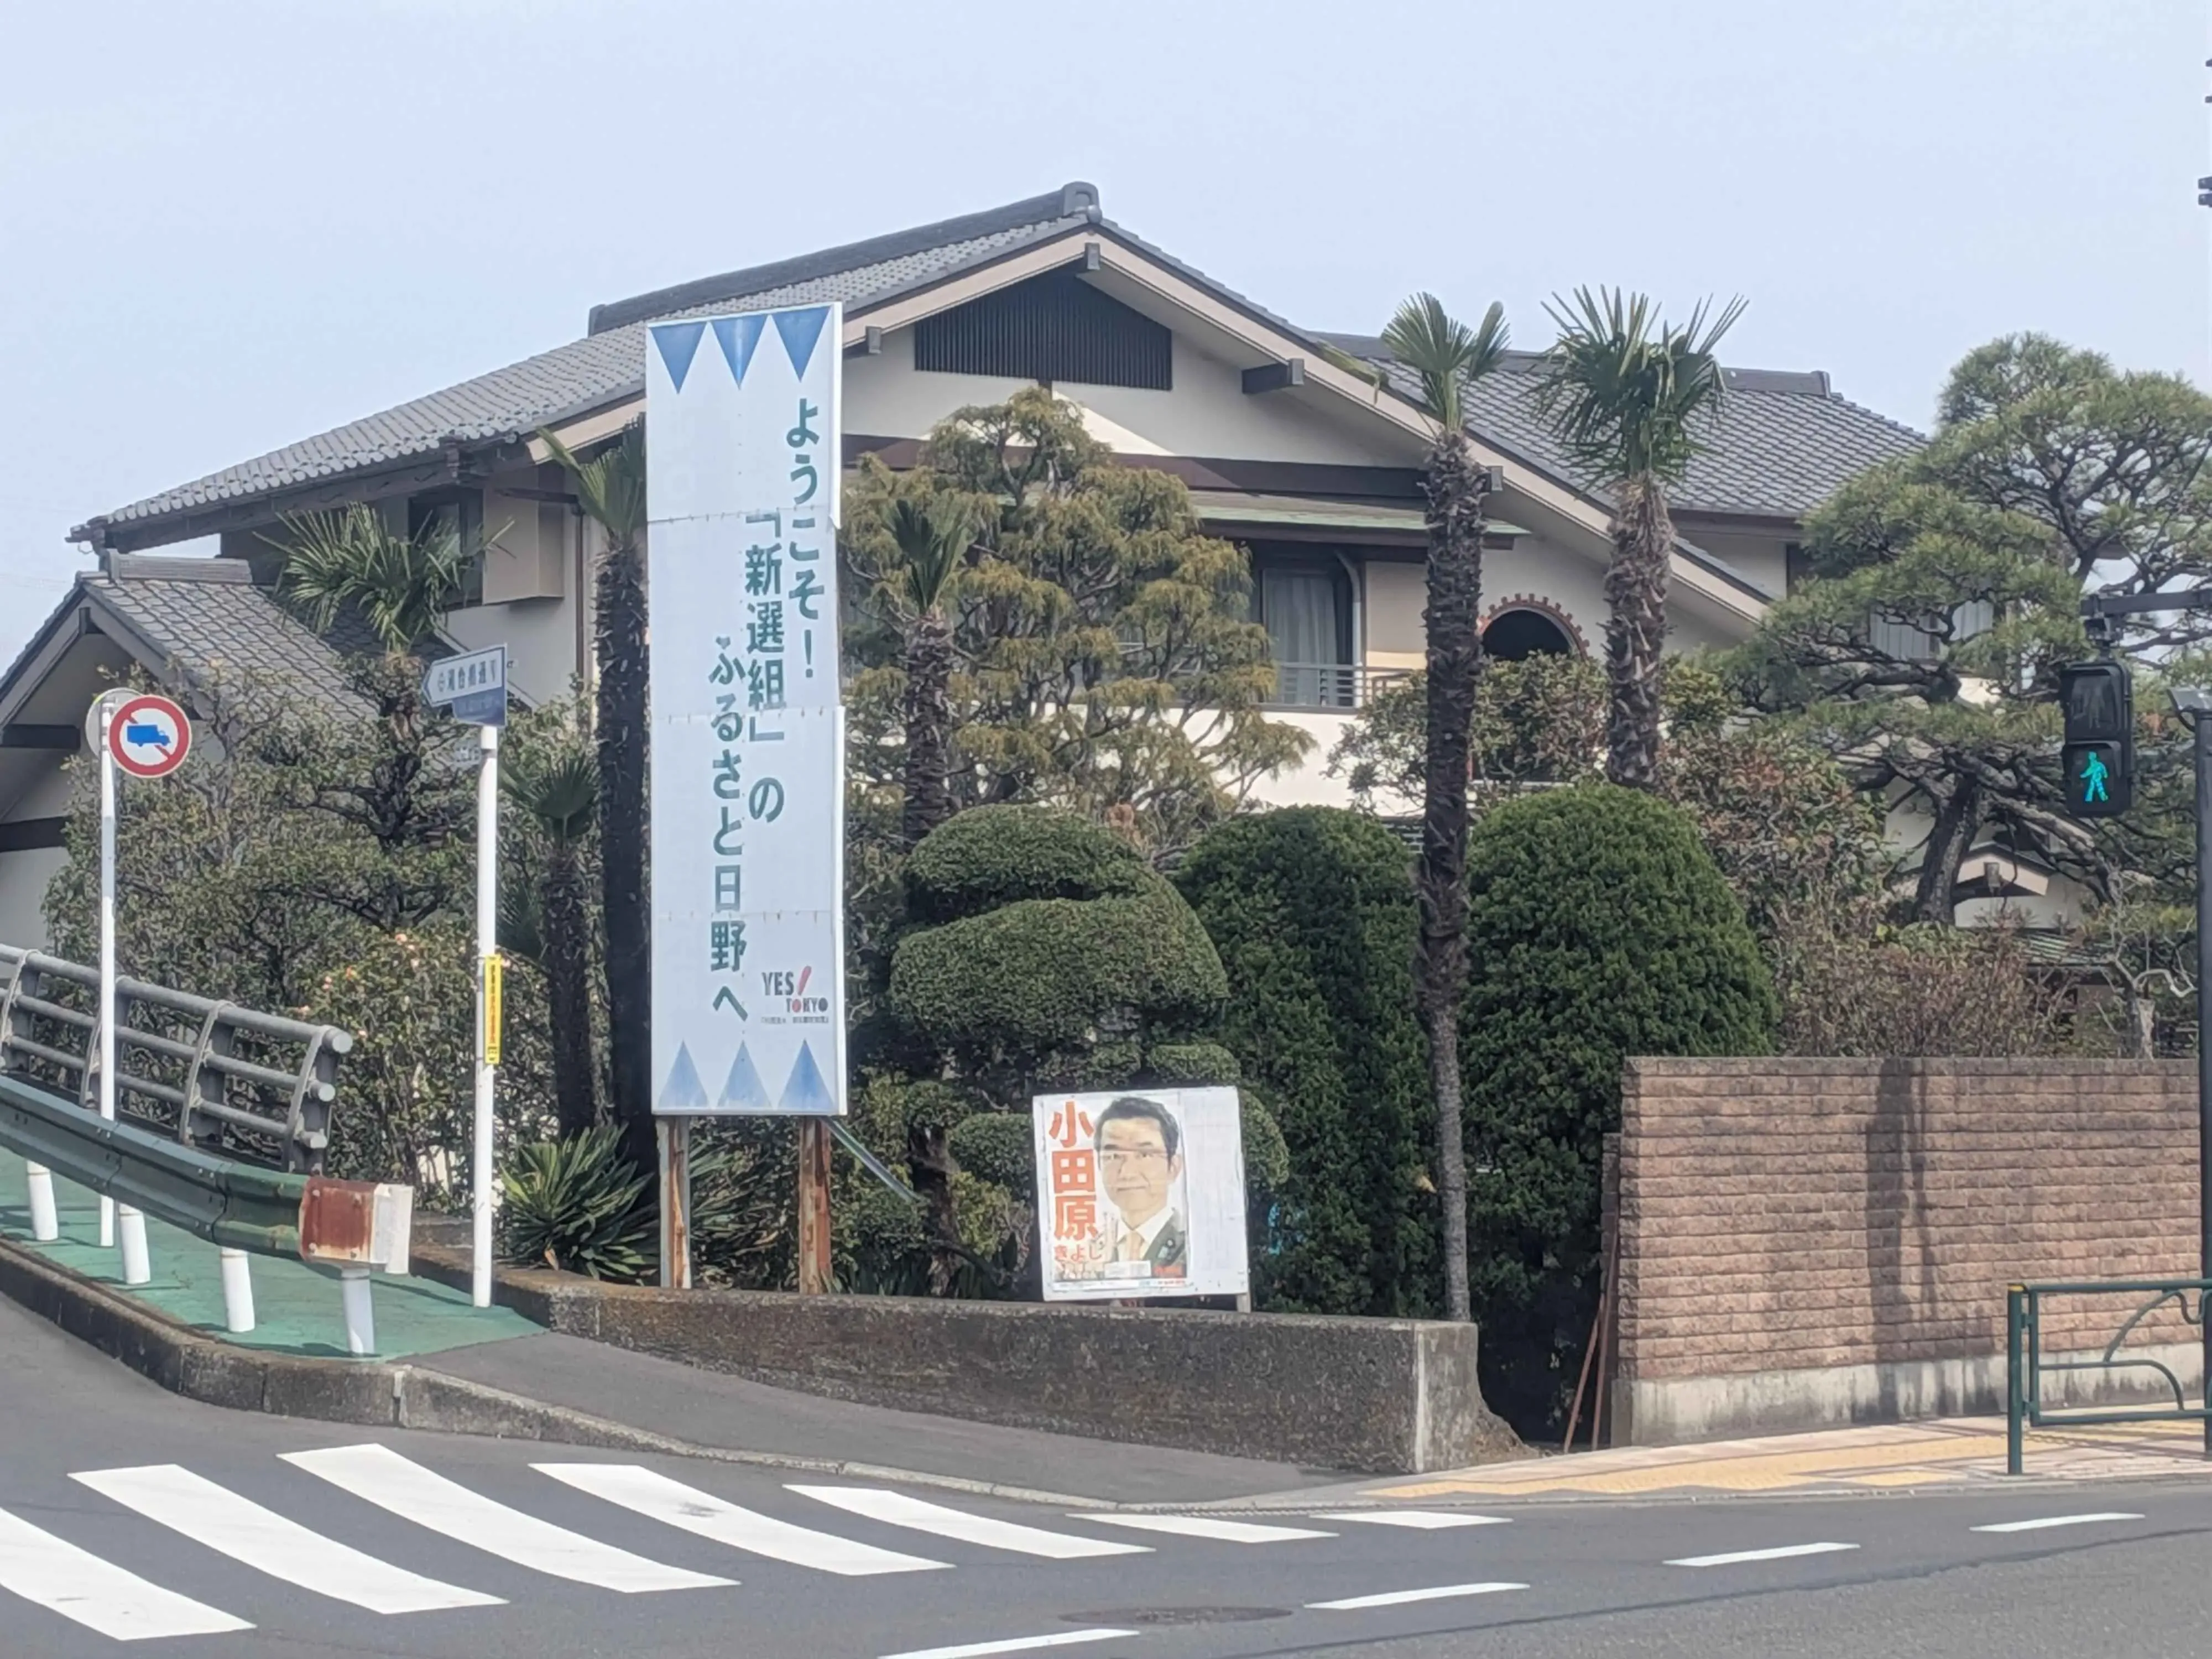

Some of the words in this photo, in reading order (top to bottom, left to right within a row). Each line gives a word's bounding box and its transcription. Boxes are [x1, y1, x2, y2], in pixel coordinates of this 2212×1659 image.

[787, 398, 824, 679] ようこそ!
[709, 637, 748, 1022] ふるさと日野へ
[786, 997, 828, 1013] TOKYO
[1049, 1102, 1098, 1240] 小田原
